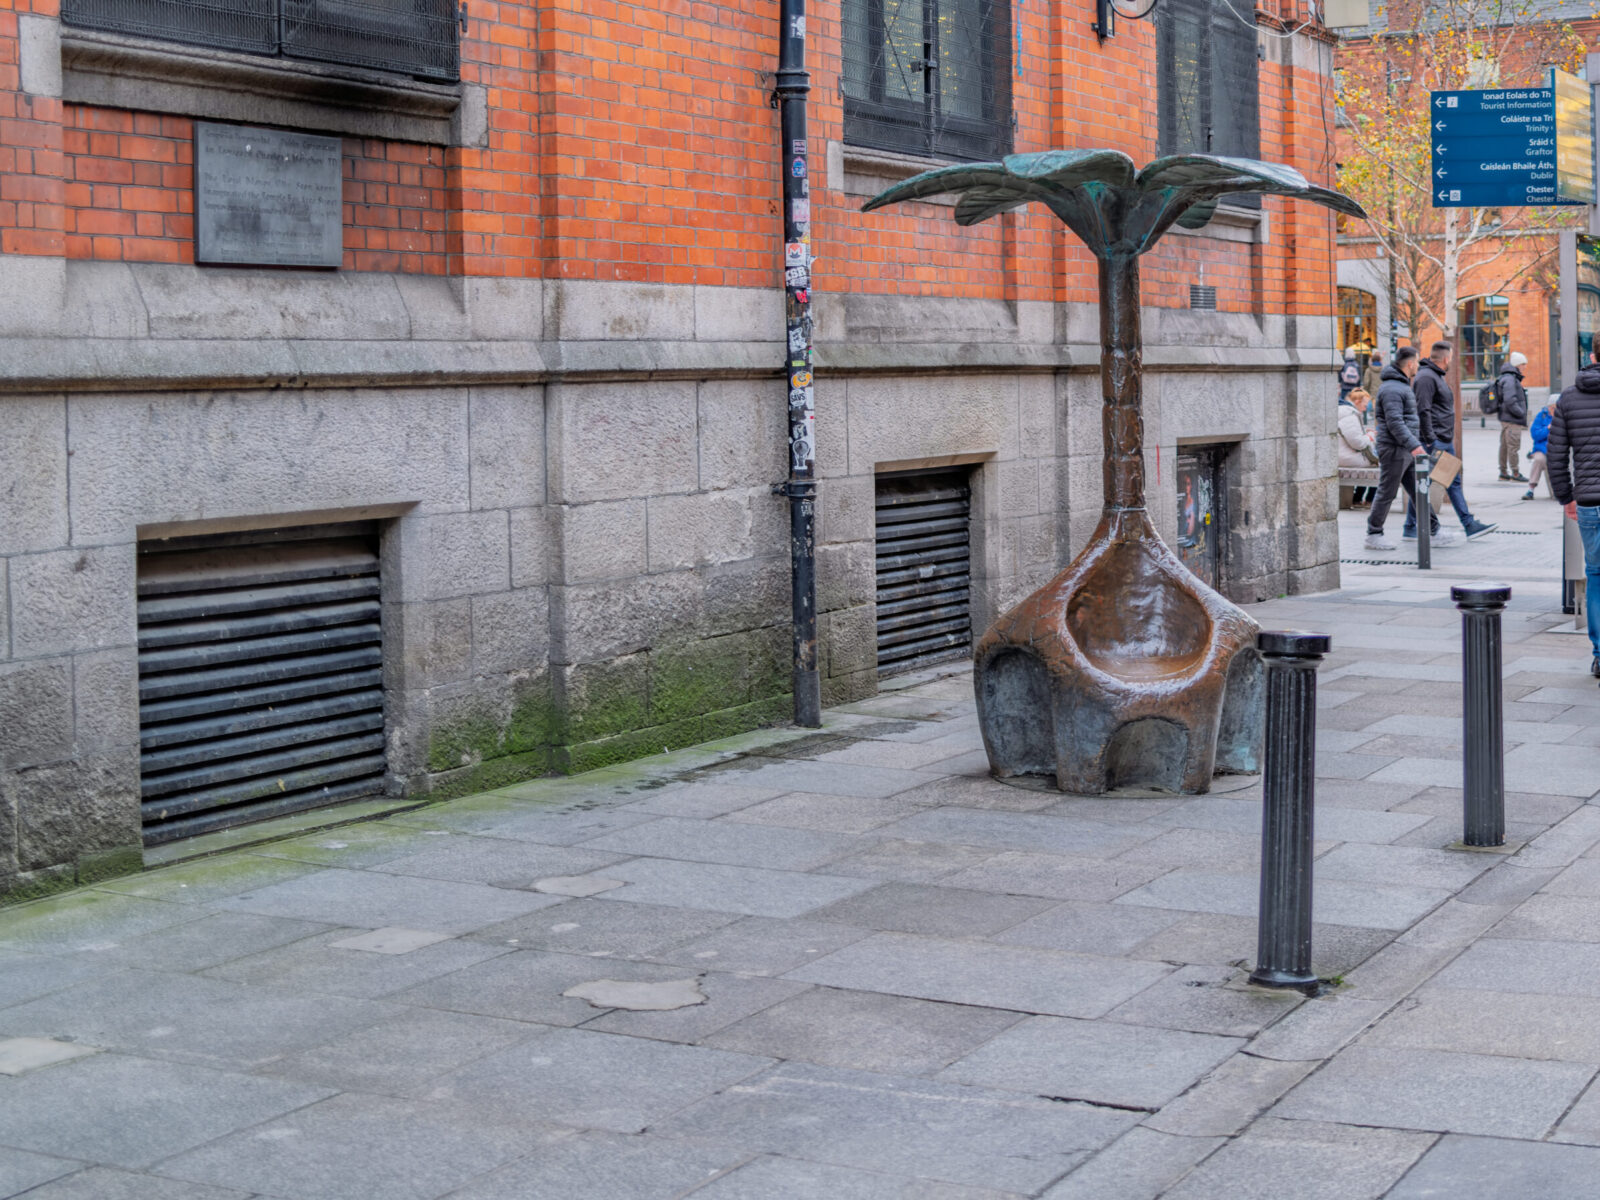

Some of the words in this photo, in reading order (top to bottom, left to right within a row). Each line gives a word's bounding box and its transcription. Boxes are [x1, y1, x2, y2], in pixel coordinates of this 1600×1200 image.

[1482, 92, 1505, 100] Ionad
[1506, 91, 1528, 99] Eolais
[1529, 91, 1540, 99] do
[1480, 102, 1505, 110] Tourist
[1507, 101, 1552, 109] Information
[1501, 115, 1531, 123] Coláiste
[1526, 124, 1549, 134] Trinity
[1529, 138, 1549, 146] Sráid
[1513, 161, 1536, 170] Bhaile
[1526, 195, 1554, 203] Chester
